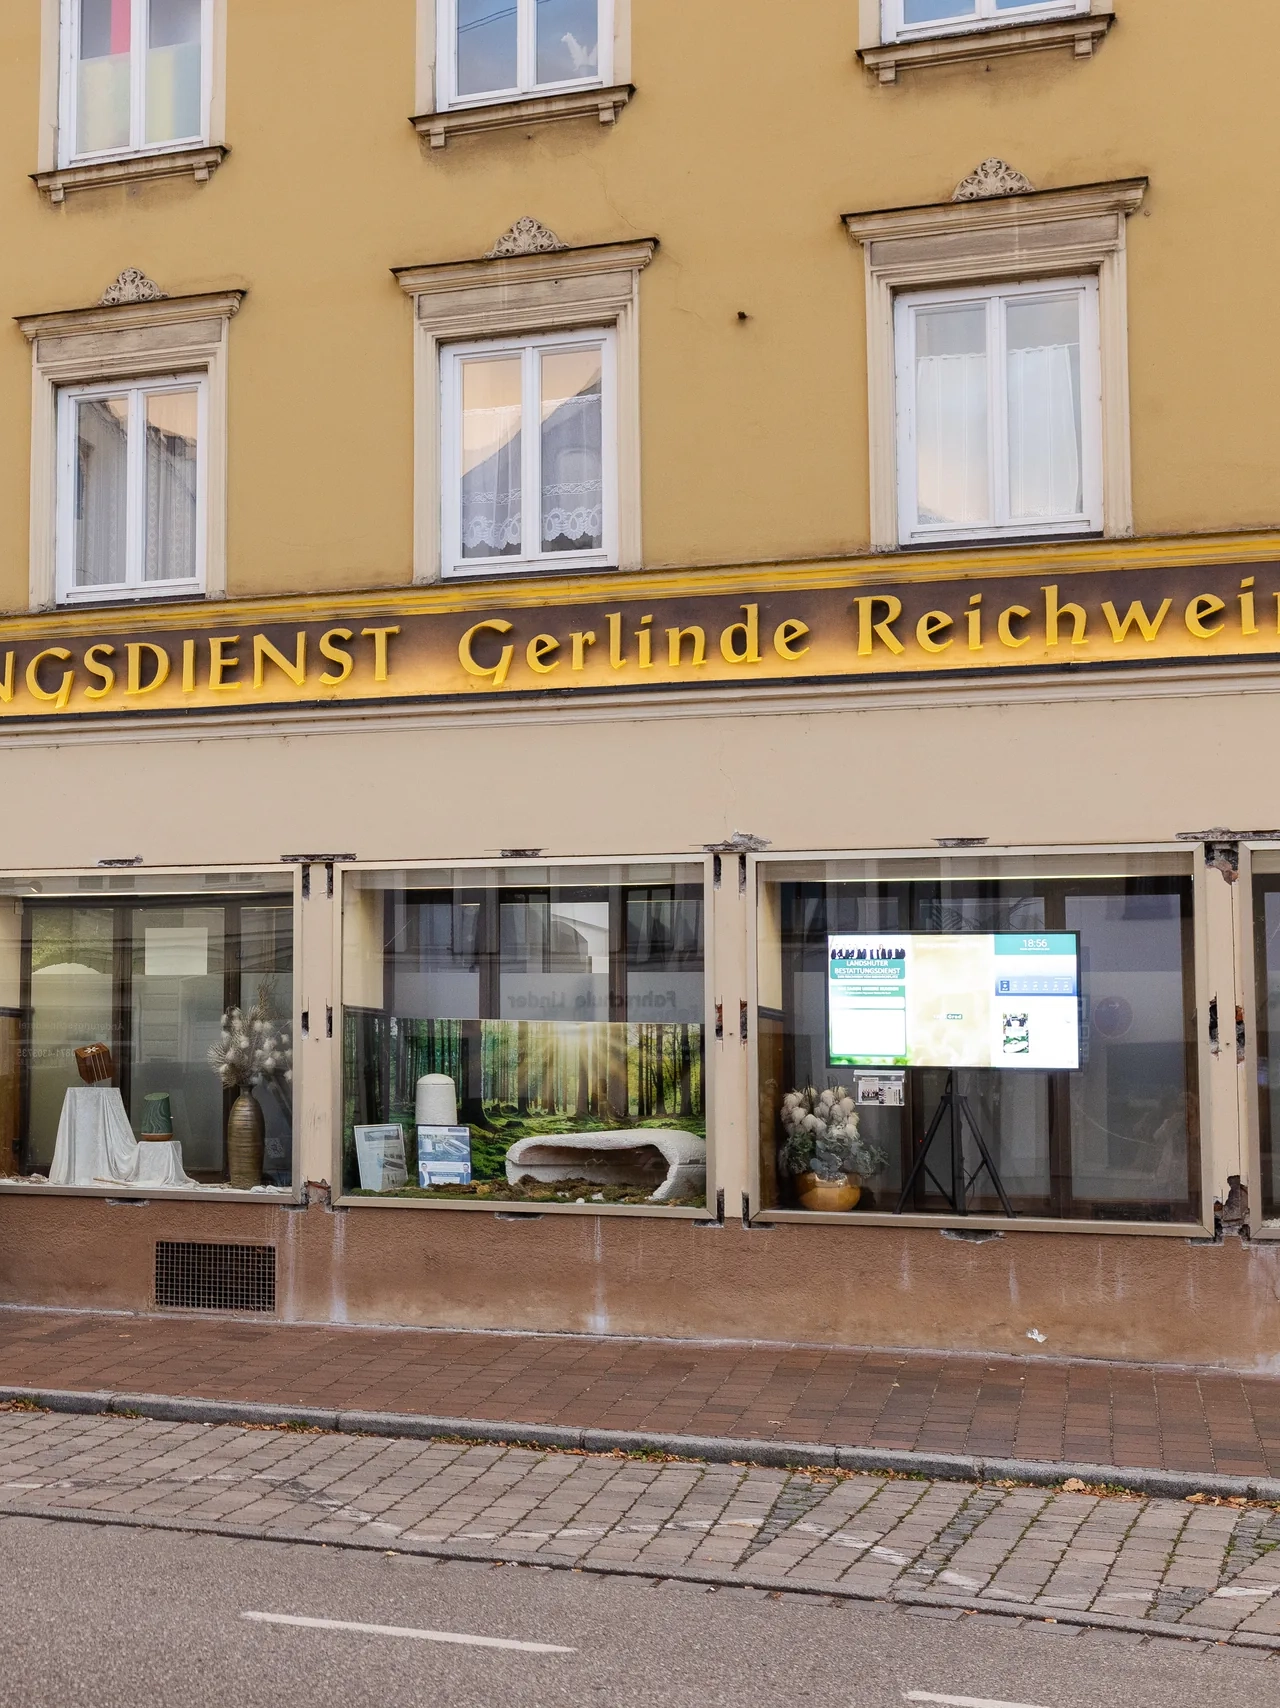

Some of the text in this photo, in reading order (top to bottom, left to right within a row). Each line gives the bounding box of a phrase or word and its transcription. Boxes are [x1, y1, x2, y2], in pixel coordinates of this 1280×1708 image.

[457, 602, 811, 686] Gerlinde
[852, 575, 1280, 656] Reichwei
[1023, 939, 1048, 948] 18:56
